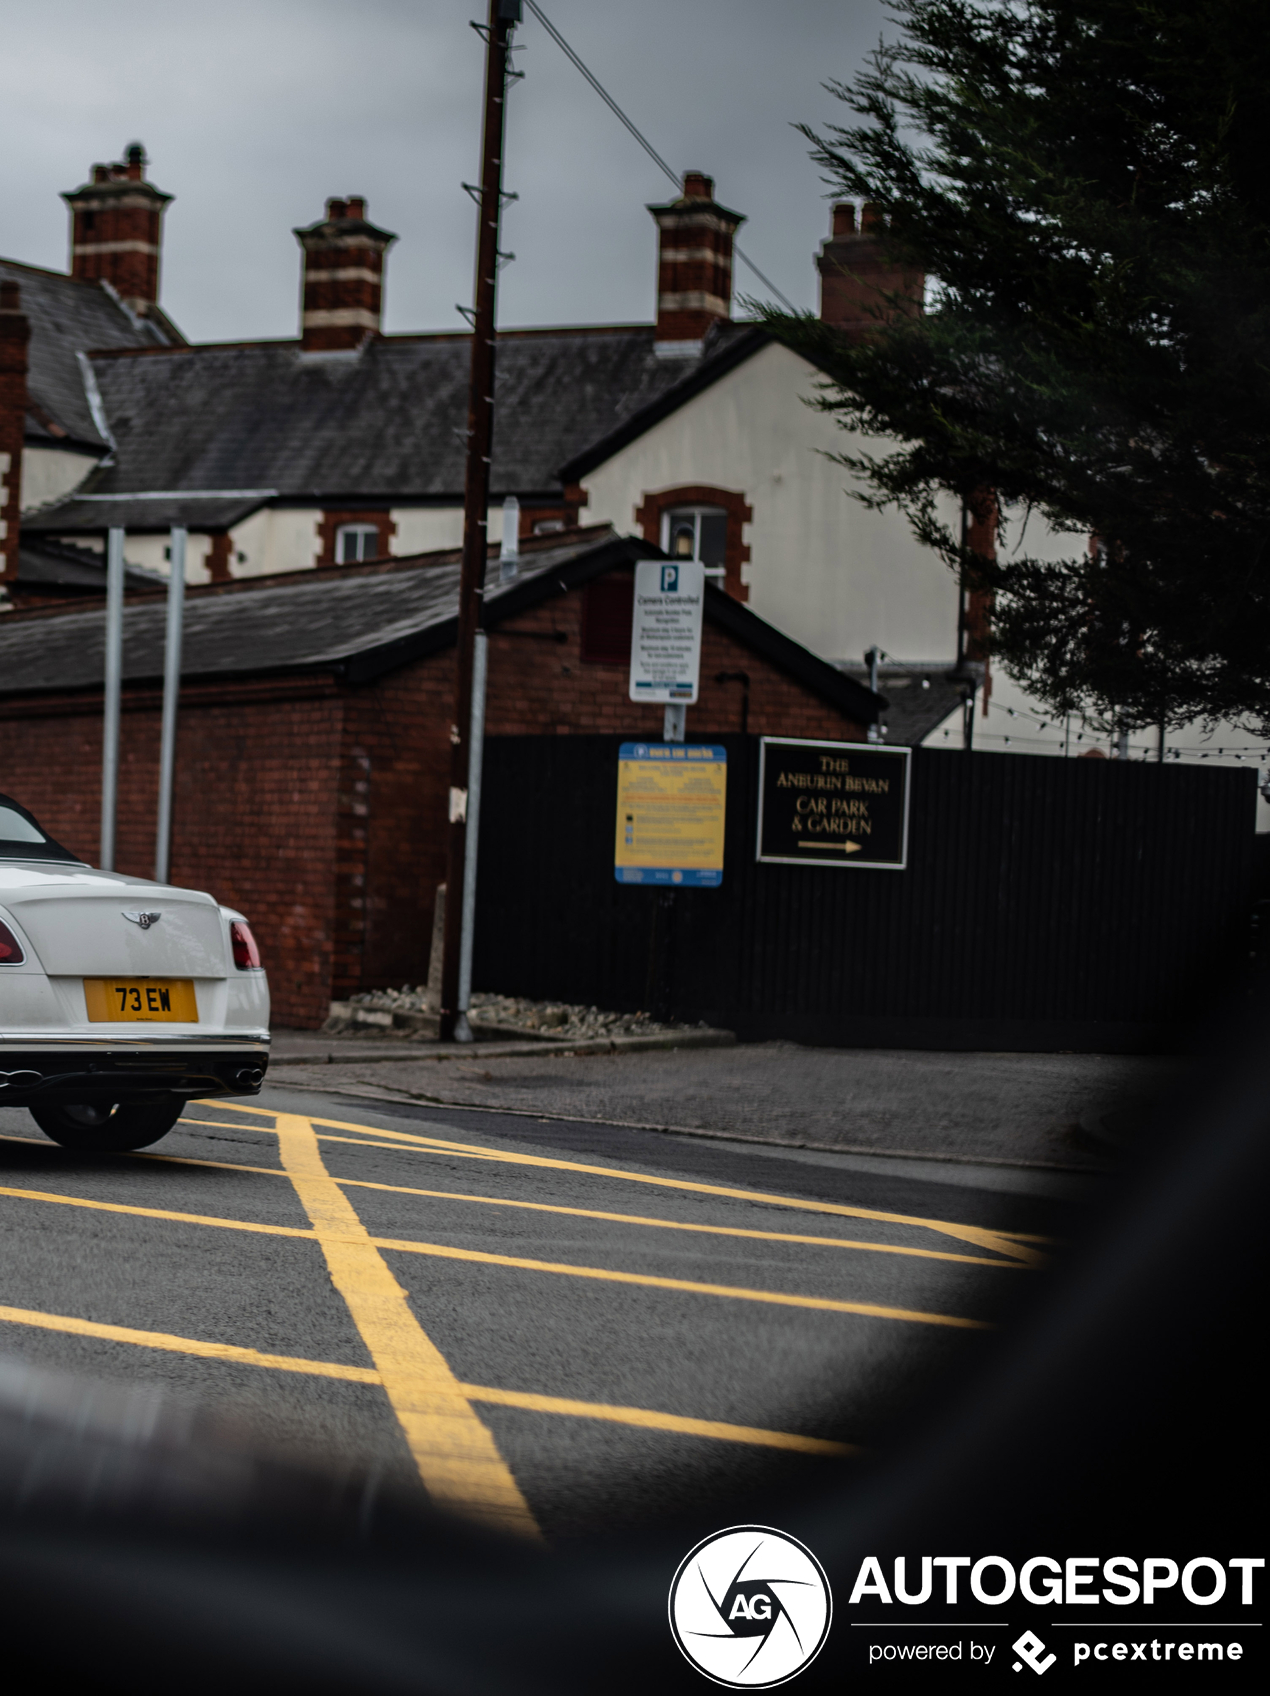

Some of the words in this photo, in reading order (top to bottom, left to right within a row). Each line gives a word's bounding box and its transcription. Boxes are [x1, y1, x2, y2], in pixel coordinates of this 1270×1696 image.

[819, 756, 849, 773] THE
[777, 772, 842, 791] ANEURIN
[845, 776, 889, 794] BEVAN
[796, 796, 827, 815] CAR
[832, 799, 869, 817] PARK
[792, 815, 802, 832] &
[807, 815, 872, 835] GARDEN
[115, 988, 142, 1012] 73
[146, 988, 171, 1012] EW
